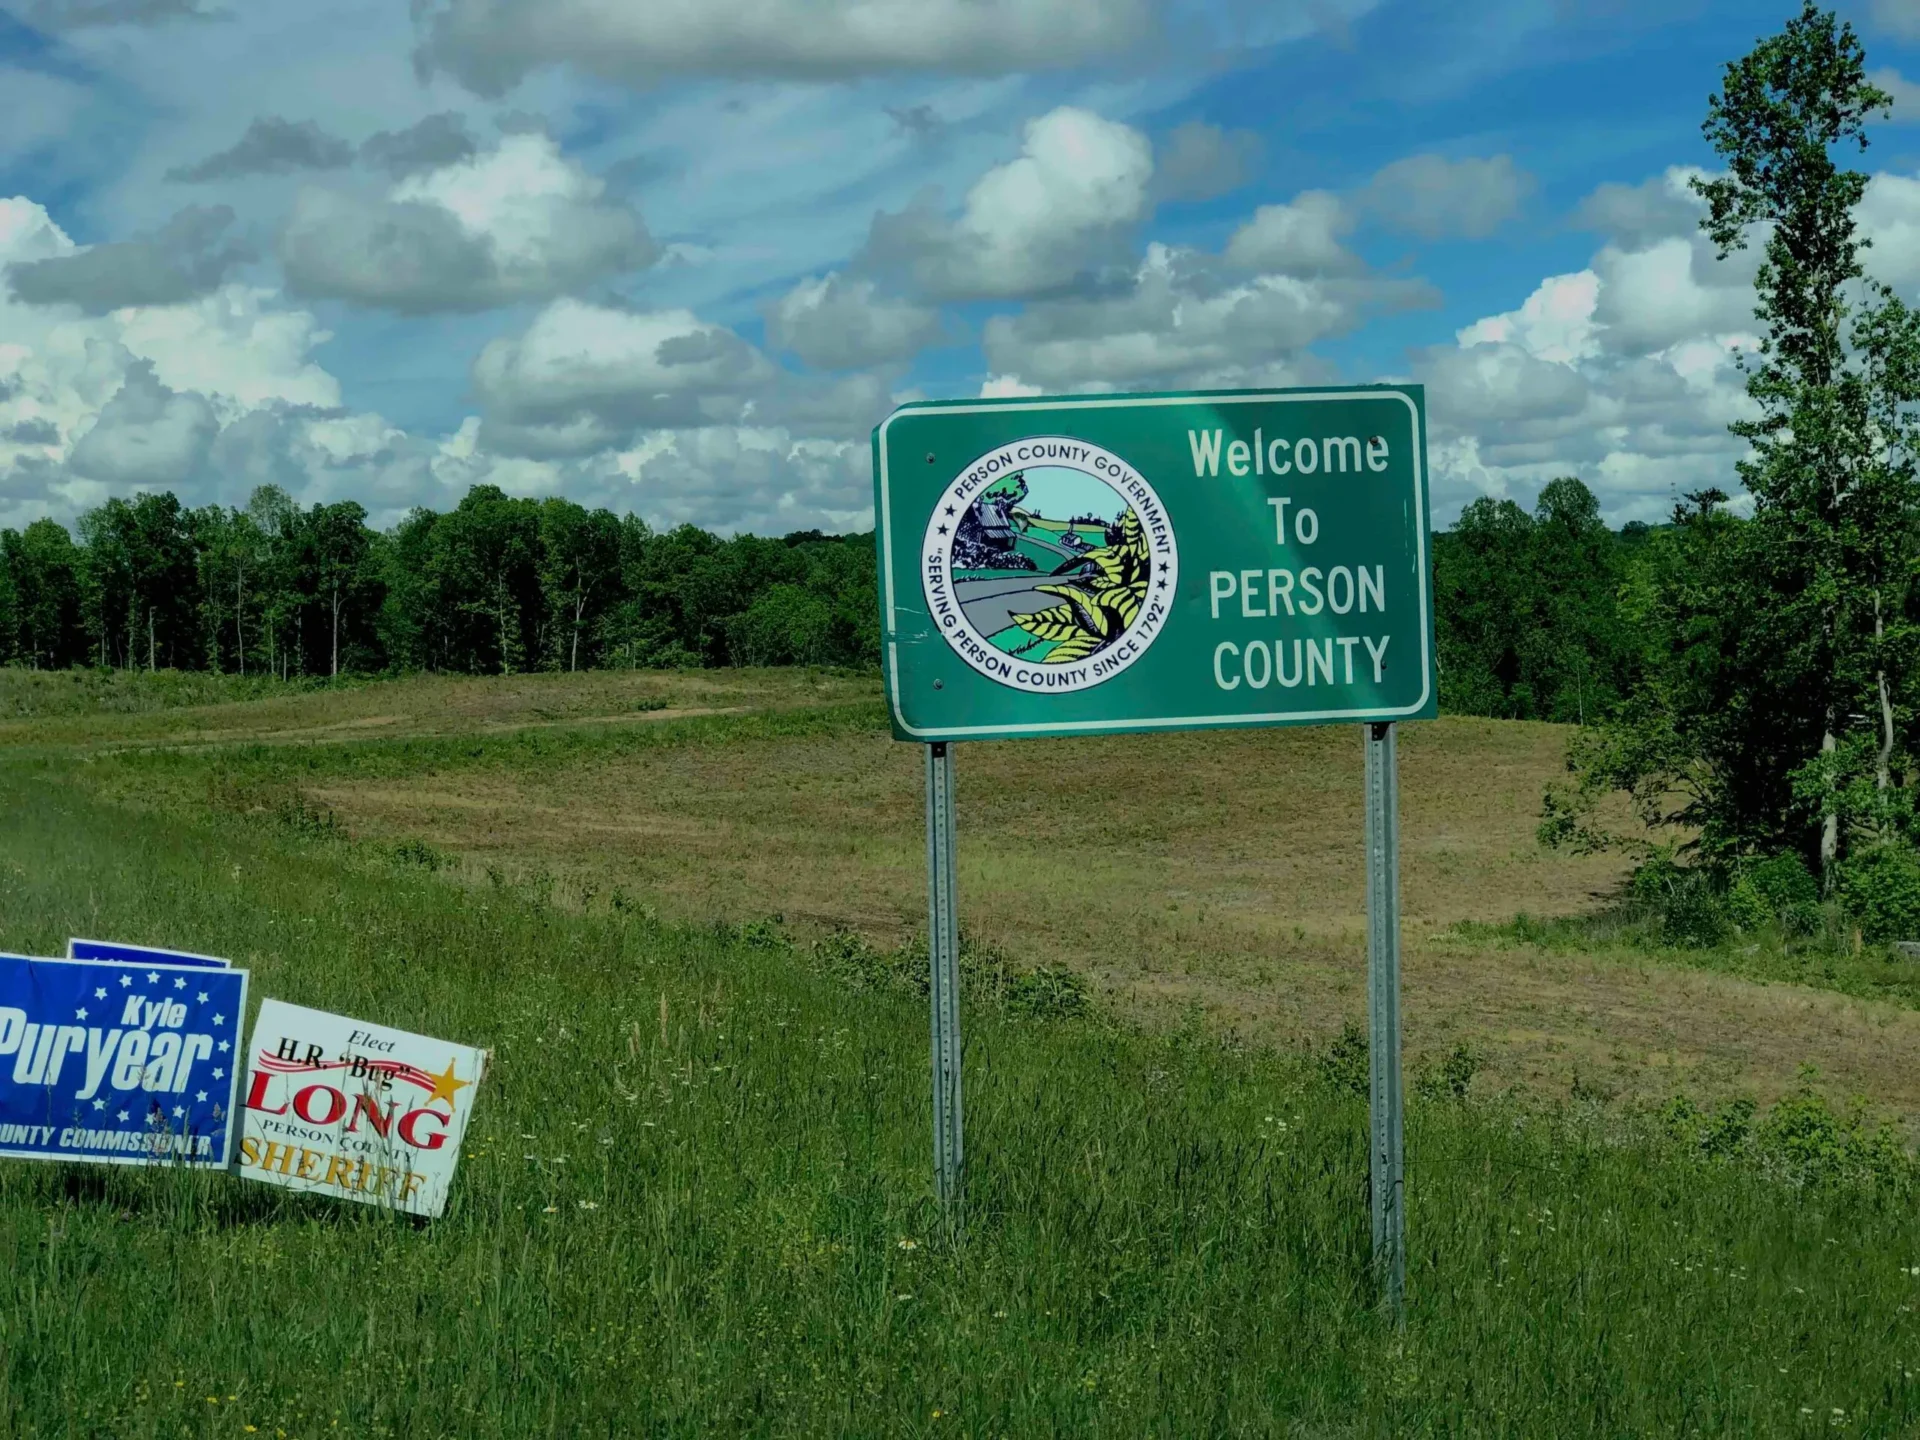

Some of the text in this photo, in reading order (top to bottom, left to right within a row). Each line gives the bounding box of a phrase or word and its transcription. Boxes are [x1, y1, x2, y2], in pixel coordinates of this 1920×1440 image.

[1188, 427, 1390, 477] Welcome
[954, 444, 1171, 555] PERSON COUNTY GOVERNMENT
[1267, 497, 1319, 545] To
[1209, 564, 1386, 619] PERSON
[952, 629, 1012, 679] PERSON
[1016, 668, 1088, 687] COUNTY
[1093, 641, 1139, 677] SINCE
[1213, 635, 1391, 690] COUNTY
[120, 994, 188, 1032] Kyle
[0, 1006, 214, 1100] Puryear
[276, 1036, 328, 1069] H.R.
[347, 1029, 397, 1053] Elect
[245, 1069, 451, 1151] LONG
[262, 1119, 336, 1145] PERSON
[0, 1123, 212, 1156] UNTY COMMISSIONR
